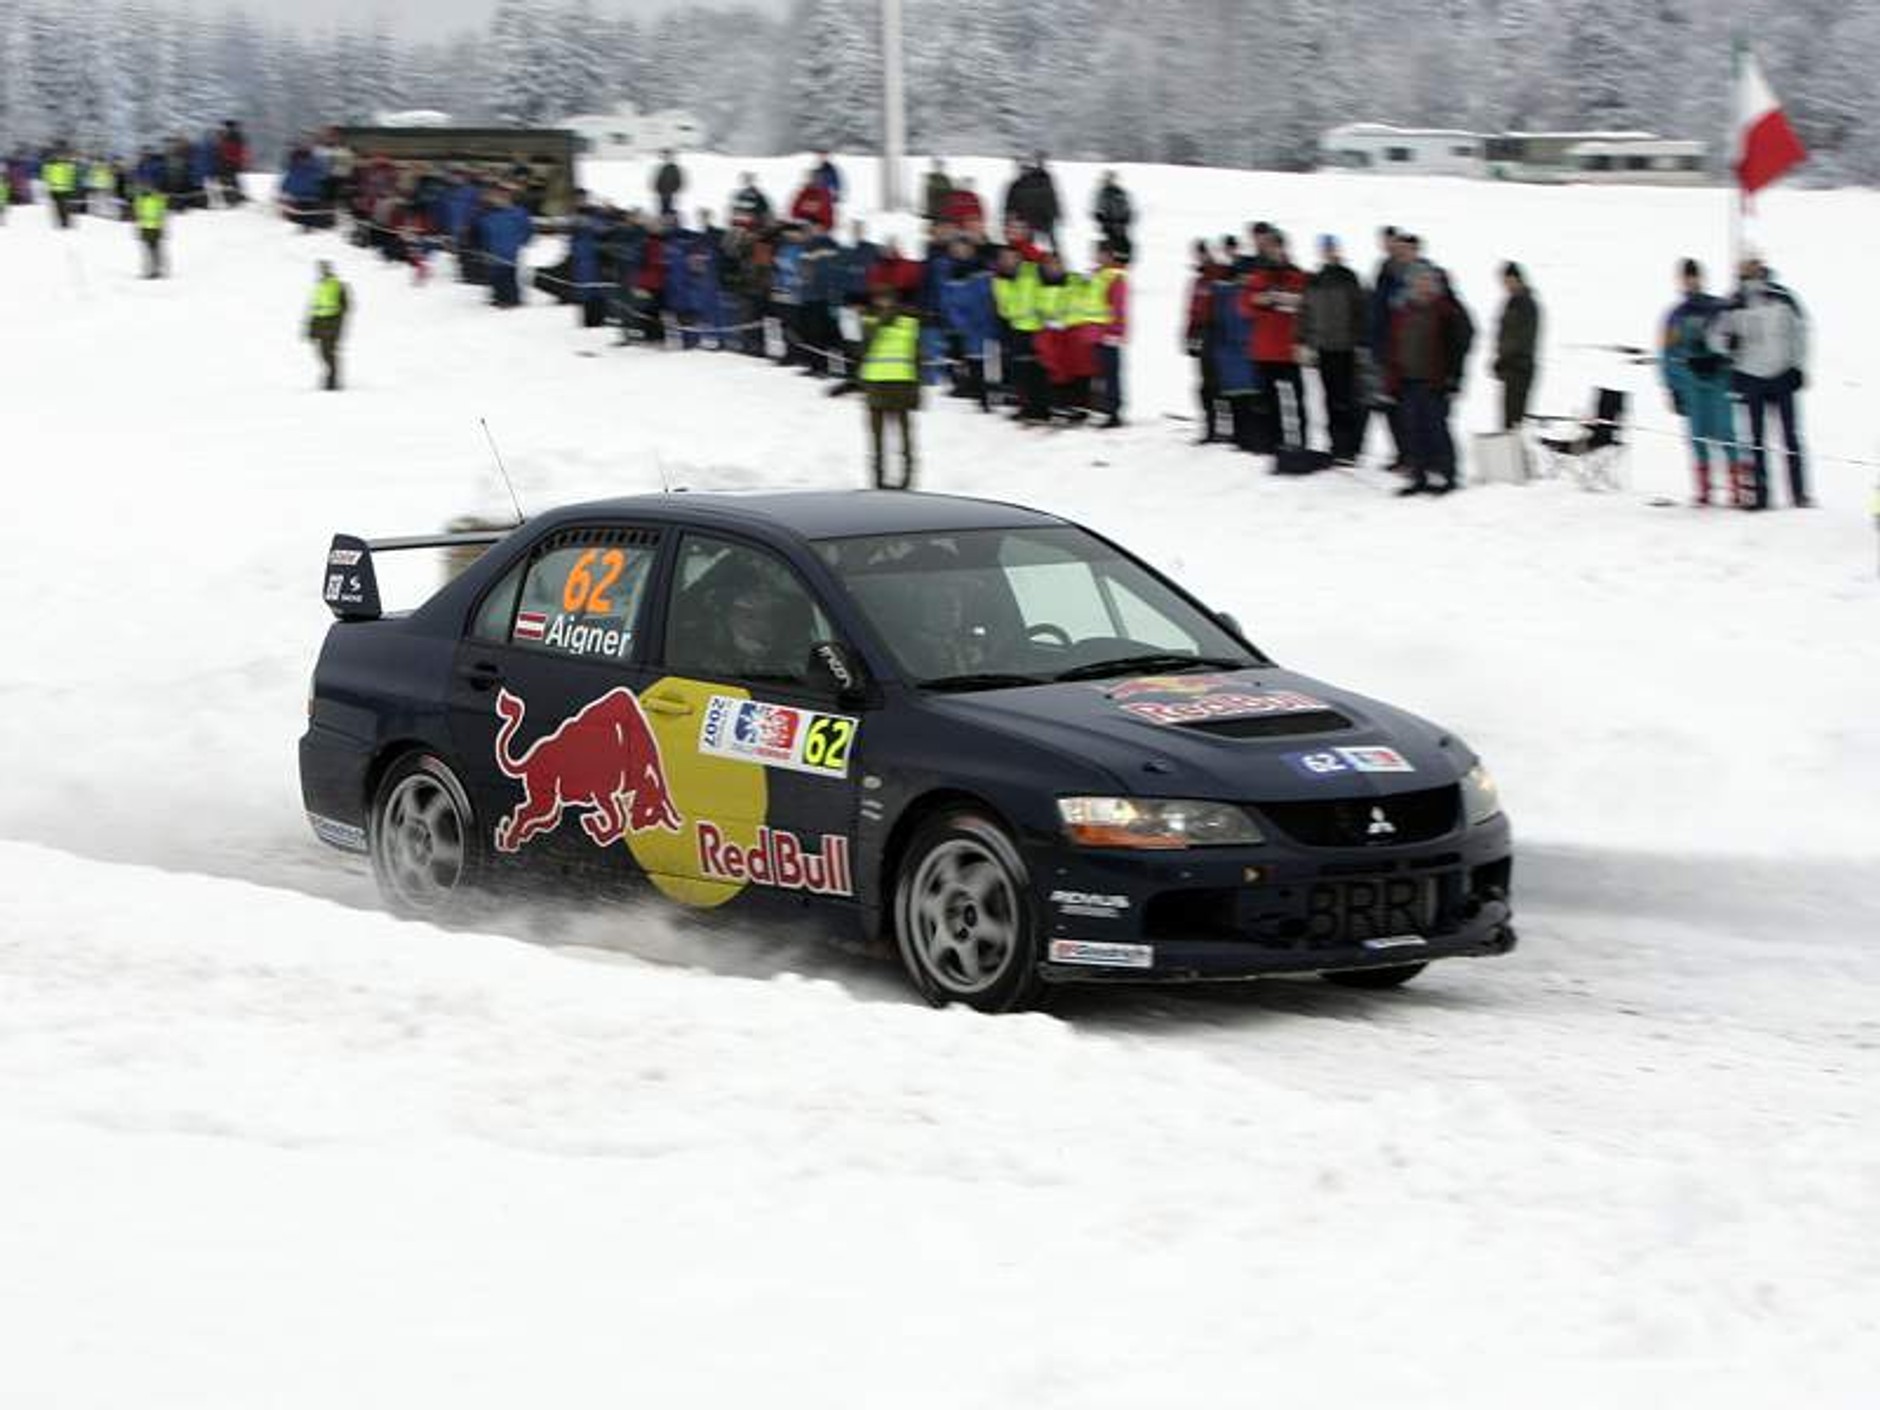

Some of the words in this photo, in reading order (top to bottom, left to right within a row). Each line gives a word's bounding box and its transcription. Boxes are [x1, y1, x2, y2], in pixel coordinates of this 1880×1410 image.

[563, 547, 626, 614] 62
[545, 613, 632, 657] Aigner
[704, 699, 725, 747] 2007
[805, 718, 851, 769] 62
[1302, 754, 1348, 773] 62
